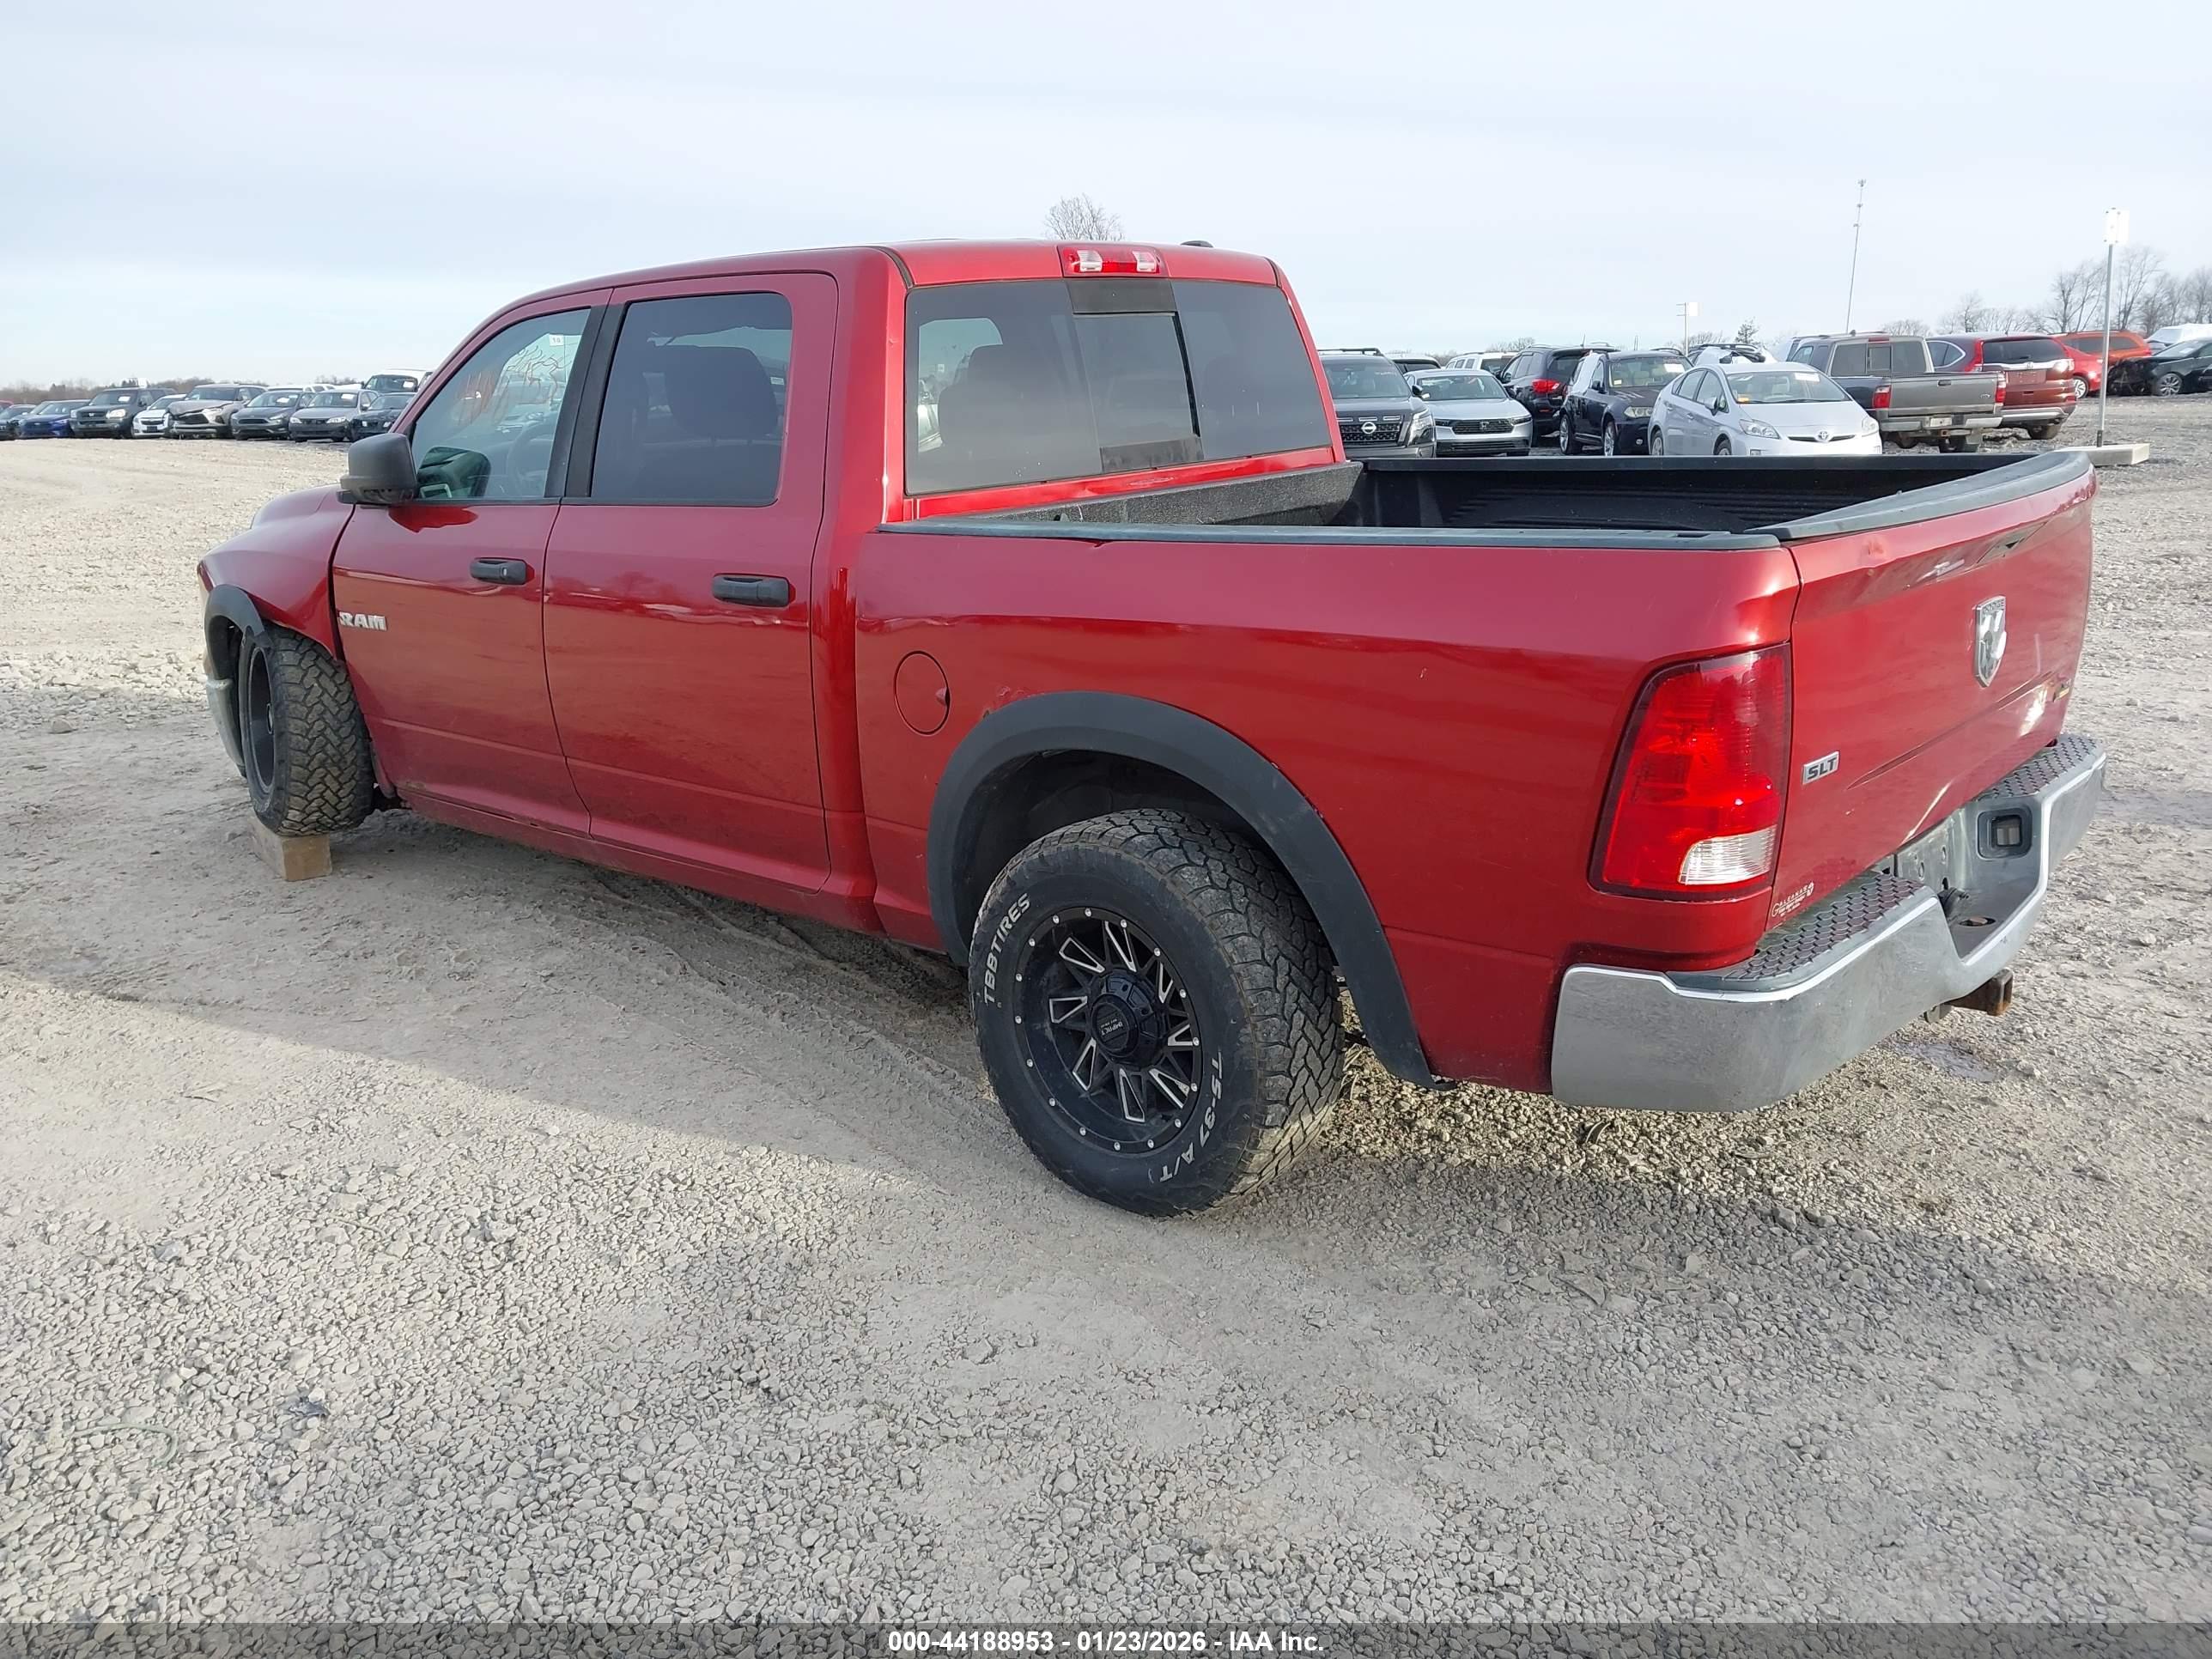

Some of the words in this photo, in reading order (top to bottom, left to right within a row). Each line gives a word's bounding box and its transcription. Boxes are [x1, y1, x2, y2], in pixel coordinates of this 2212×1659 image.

[337, 611, 387, 632] RAM
[1807, 757, 1837, 780] SLT
[983, 892, 1030, 1006] TBBTIRES
[1200, 1048, 1223, 1148] TS-37
[1159, 1141, 1195, 1183] A/T
